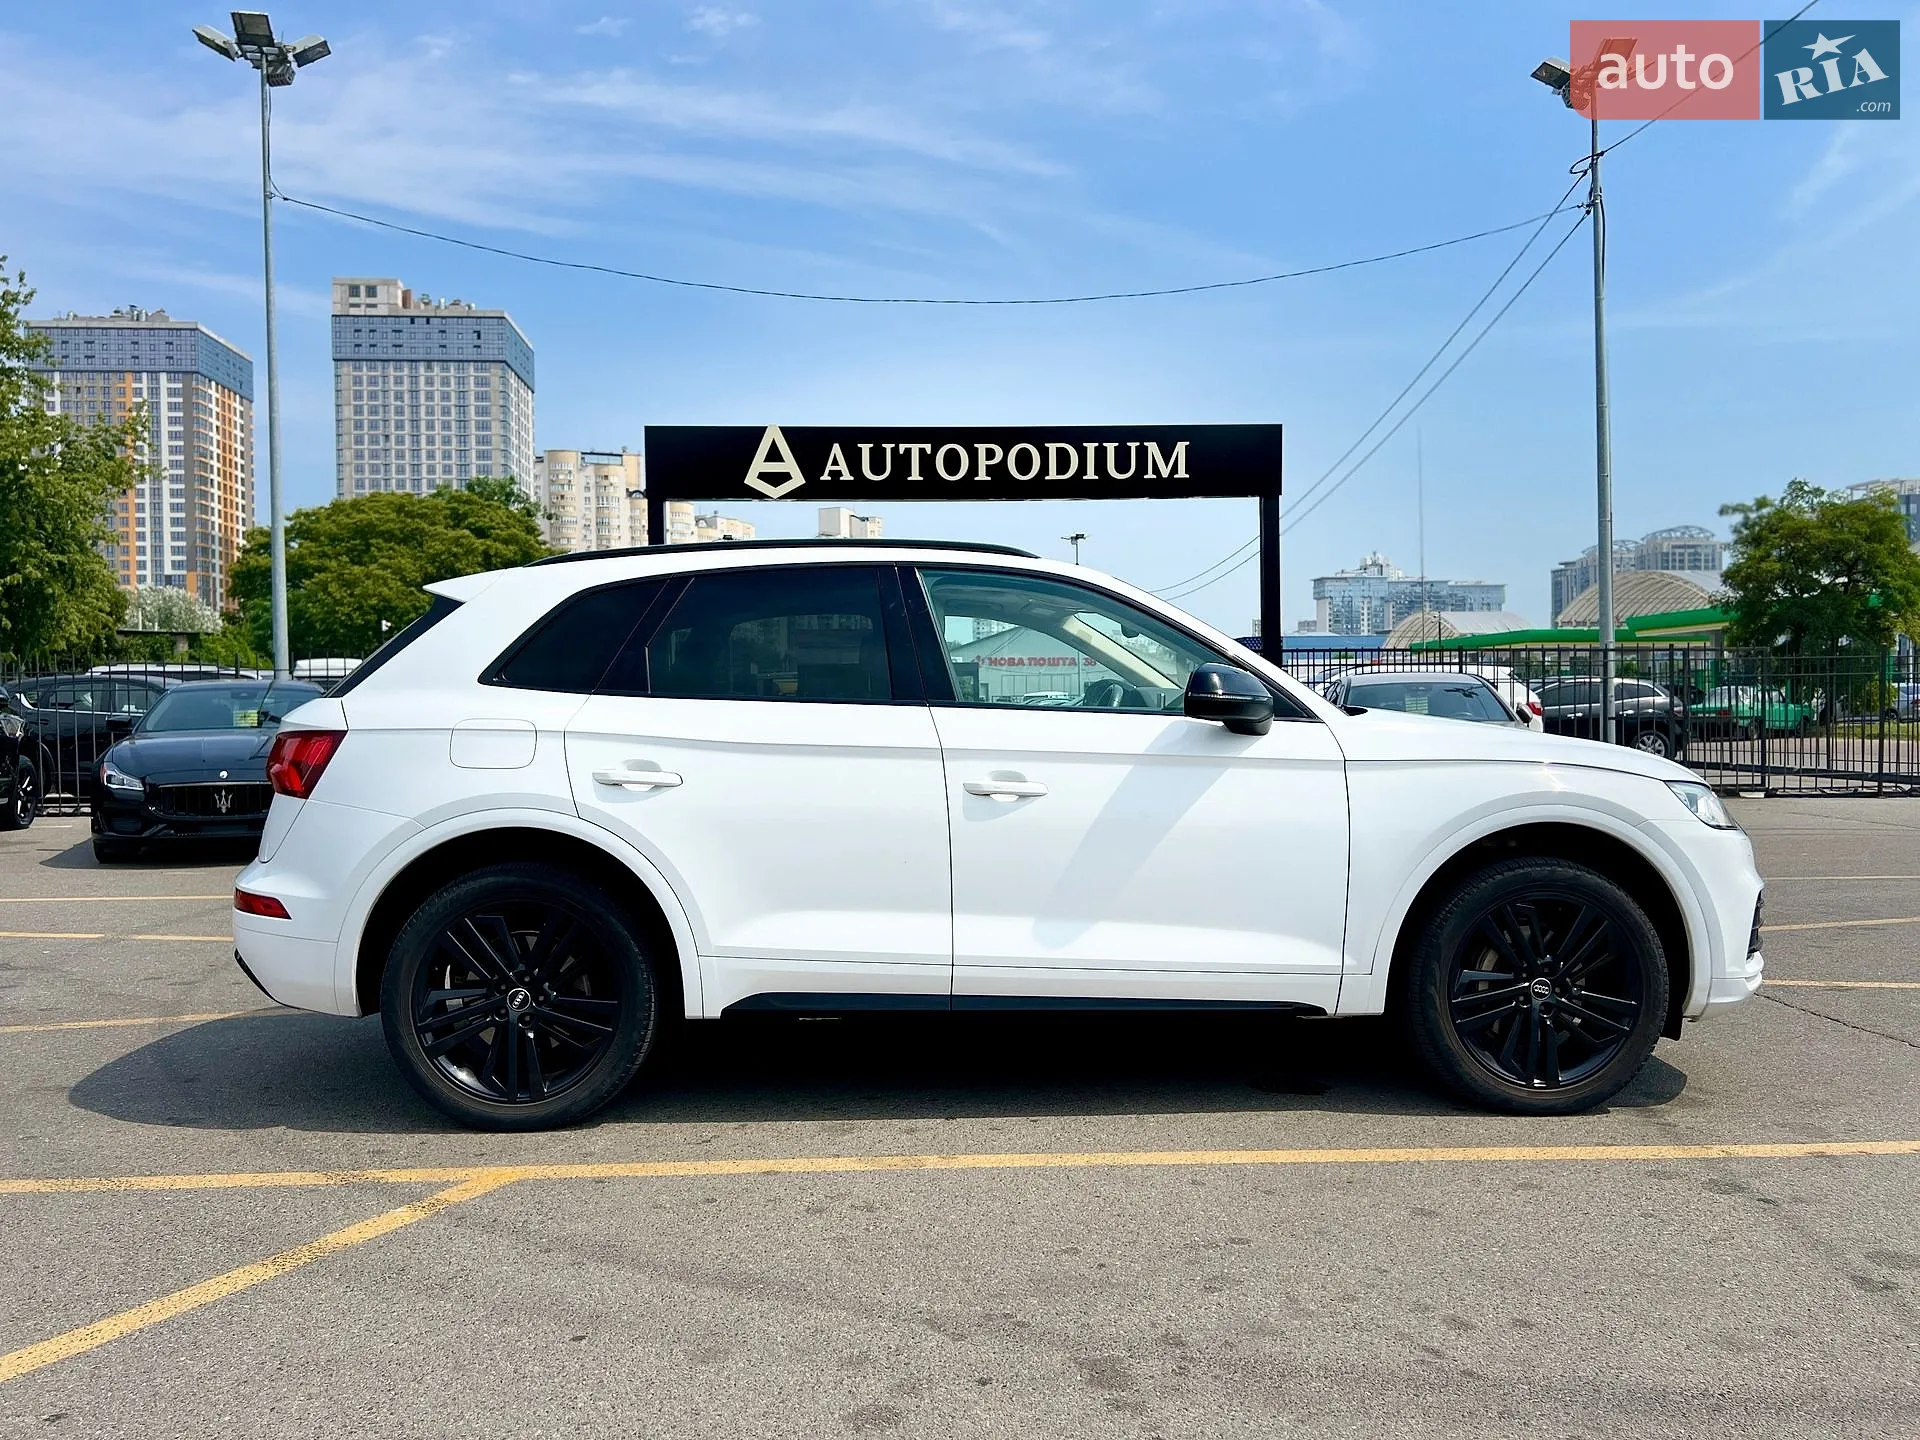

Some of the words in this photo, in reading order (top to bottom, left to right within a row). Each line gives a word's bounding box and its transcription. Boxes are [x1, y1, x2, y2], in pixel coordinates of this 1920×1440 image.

[819, 441, 1190, 481] AUTOPODIUM
[988, 656, 1025, 667] НОВА
[1027, 656, 1077, 667] ПОШТА
